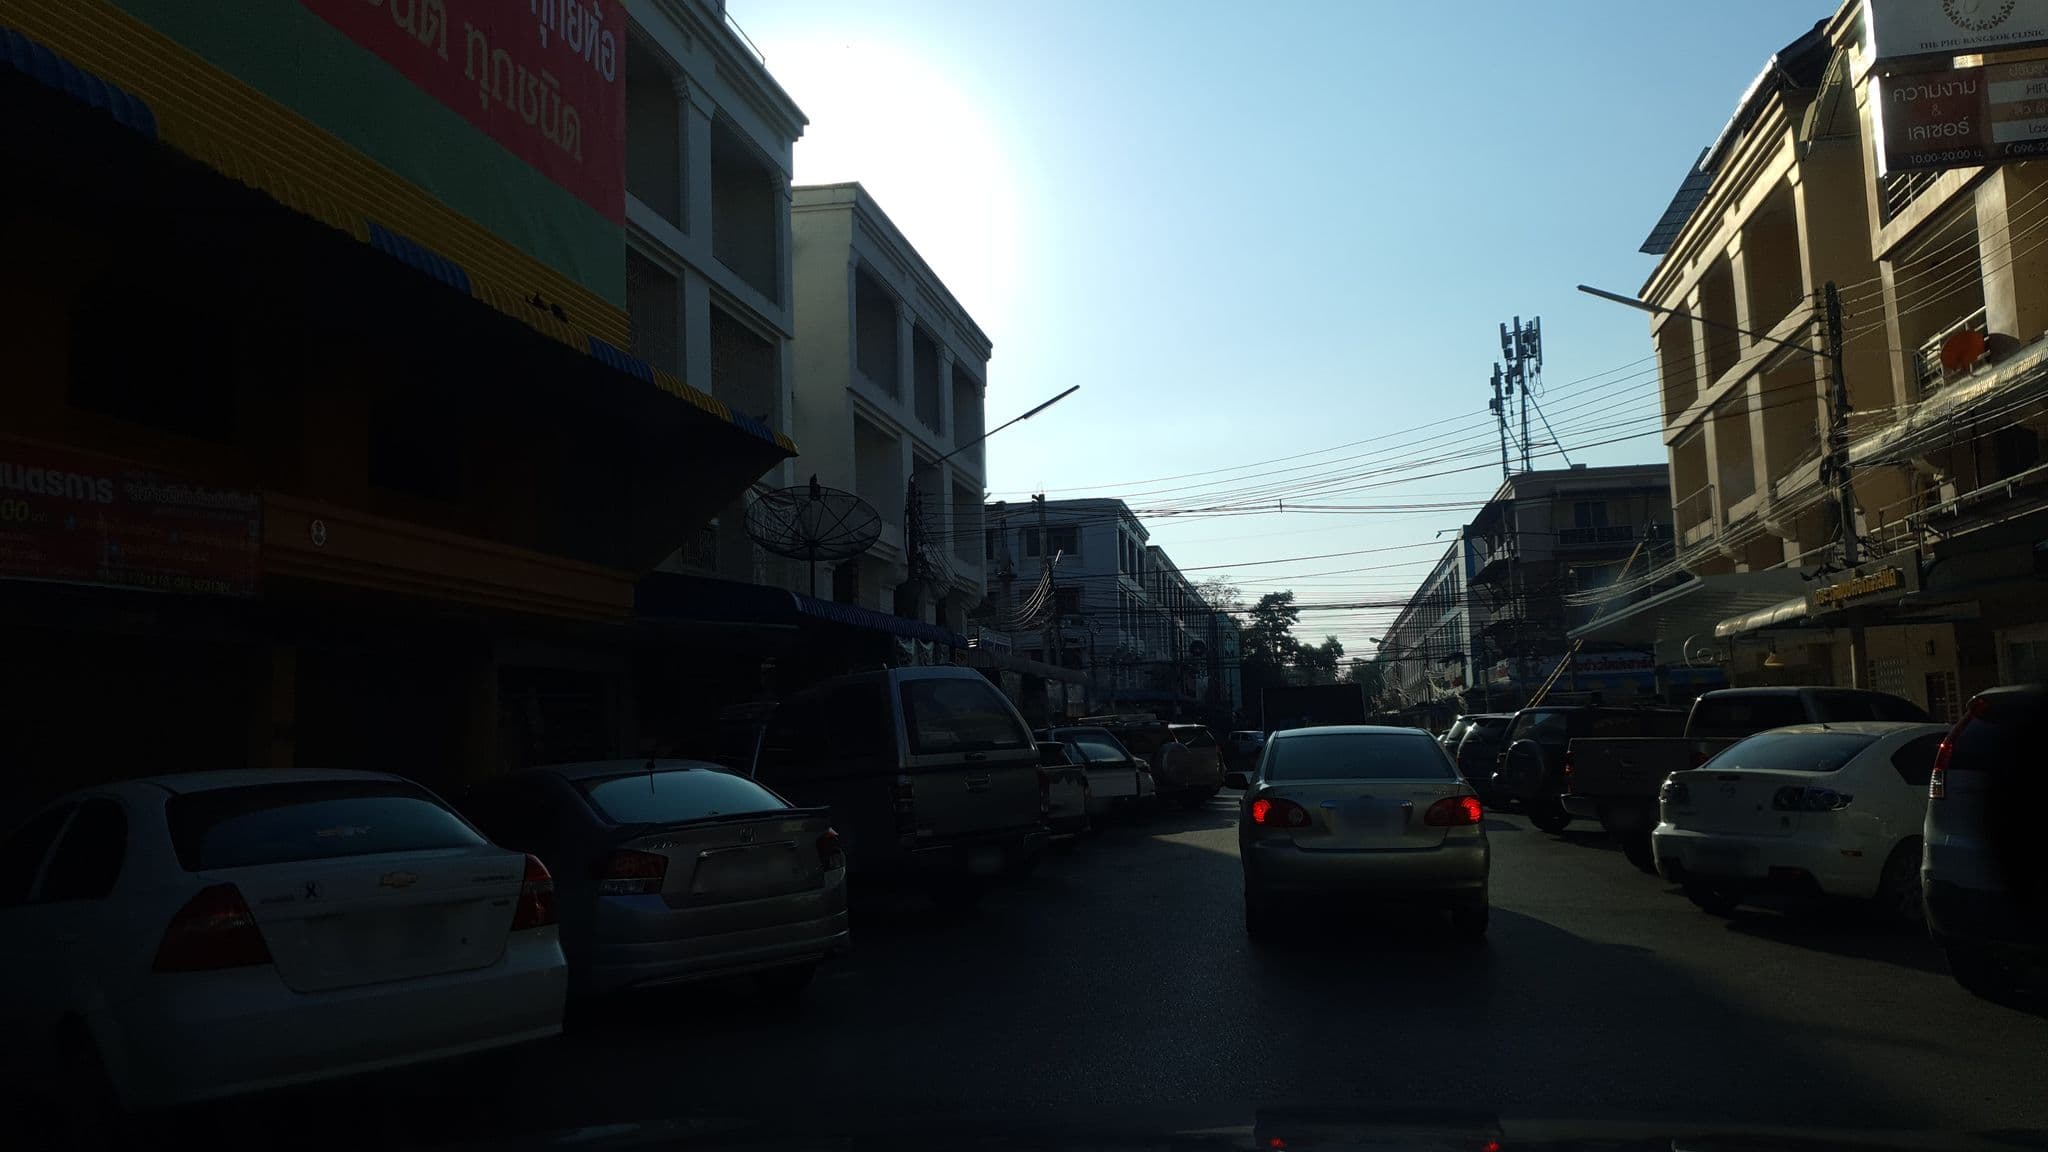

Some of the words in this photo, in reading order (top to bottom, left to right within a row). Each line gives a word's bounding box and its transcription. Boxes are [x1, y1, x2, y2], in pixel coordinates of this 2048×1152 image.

[1963, 33, 2009, 45] BANGKOK
[2010, 30, 2045, 40] CLINIC
[464, 20, 583, 164] ทุกชนิด
[1893, 80, 1977, 102] ความงาม
[1908, 116, 1970, 141] เลเซอร์
